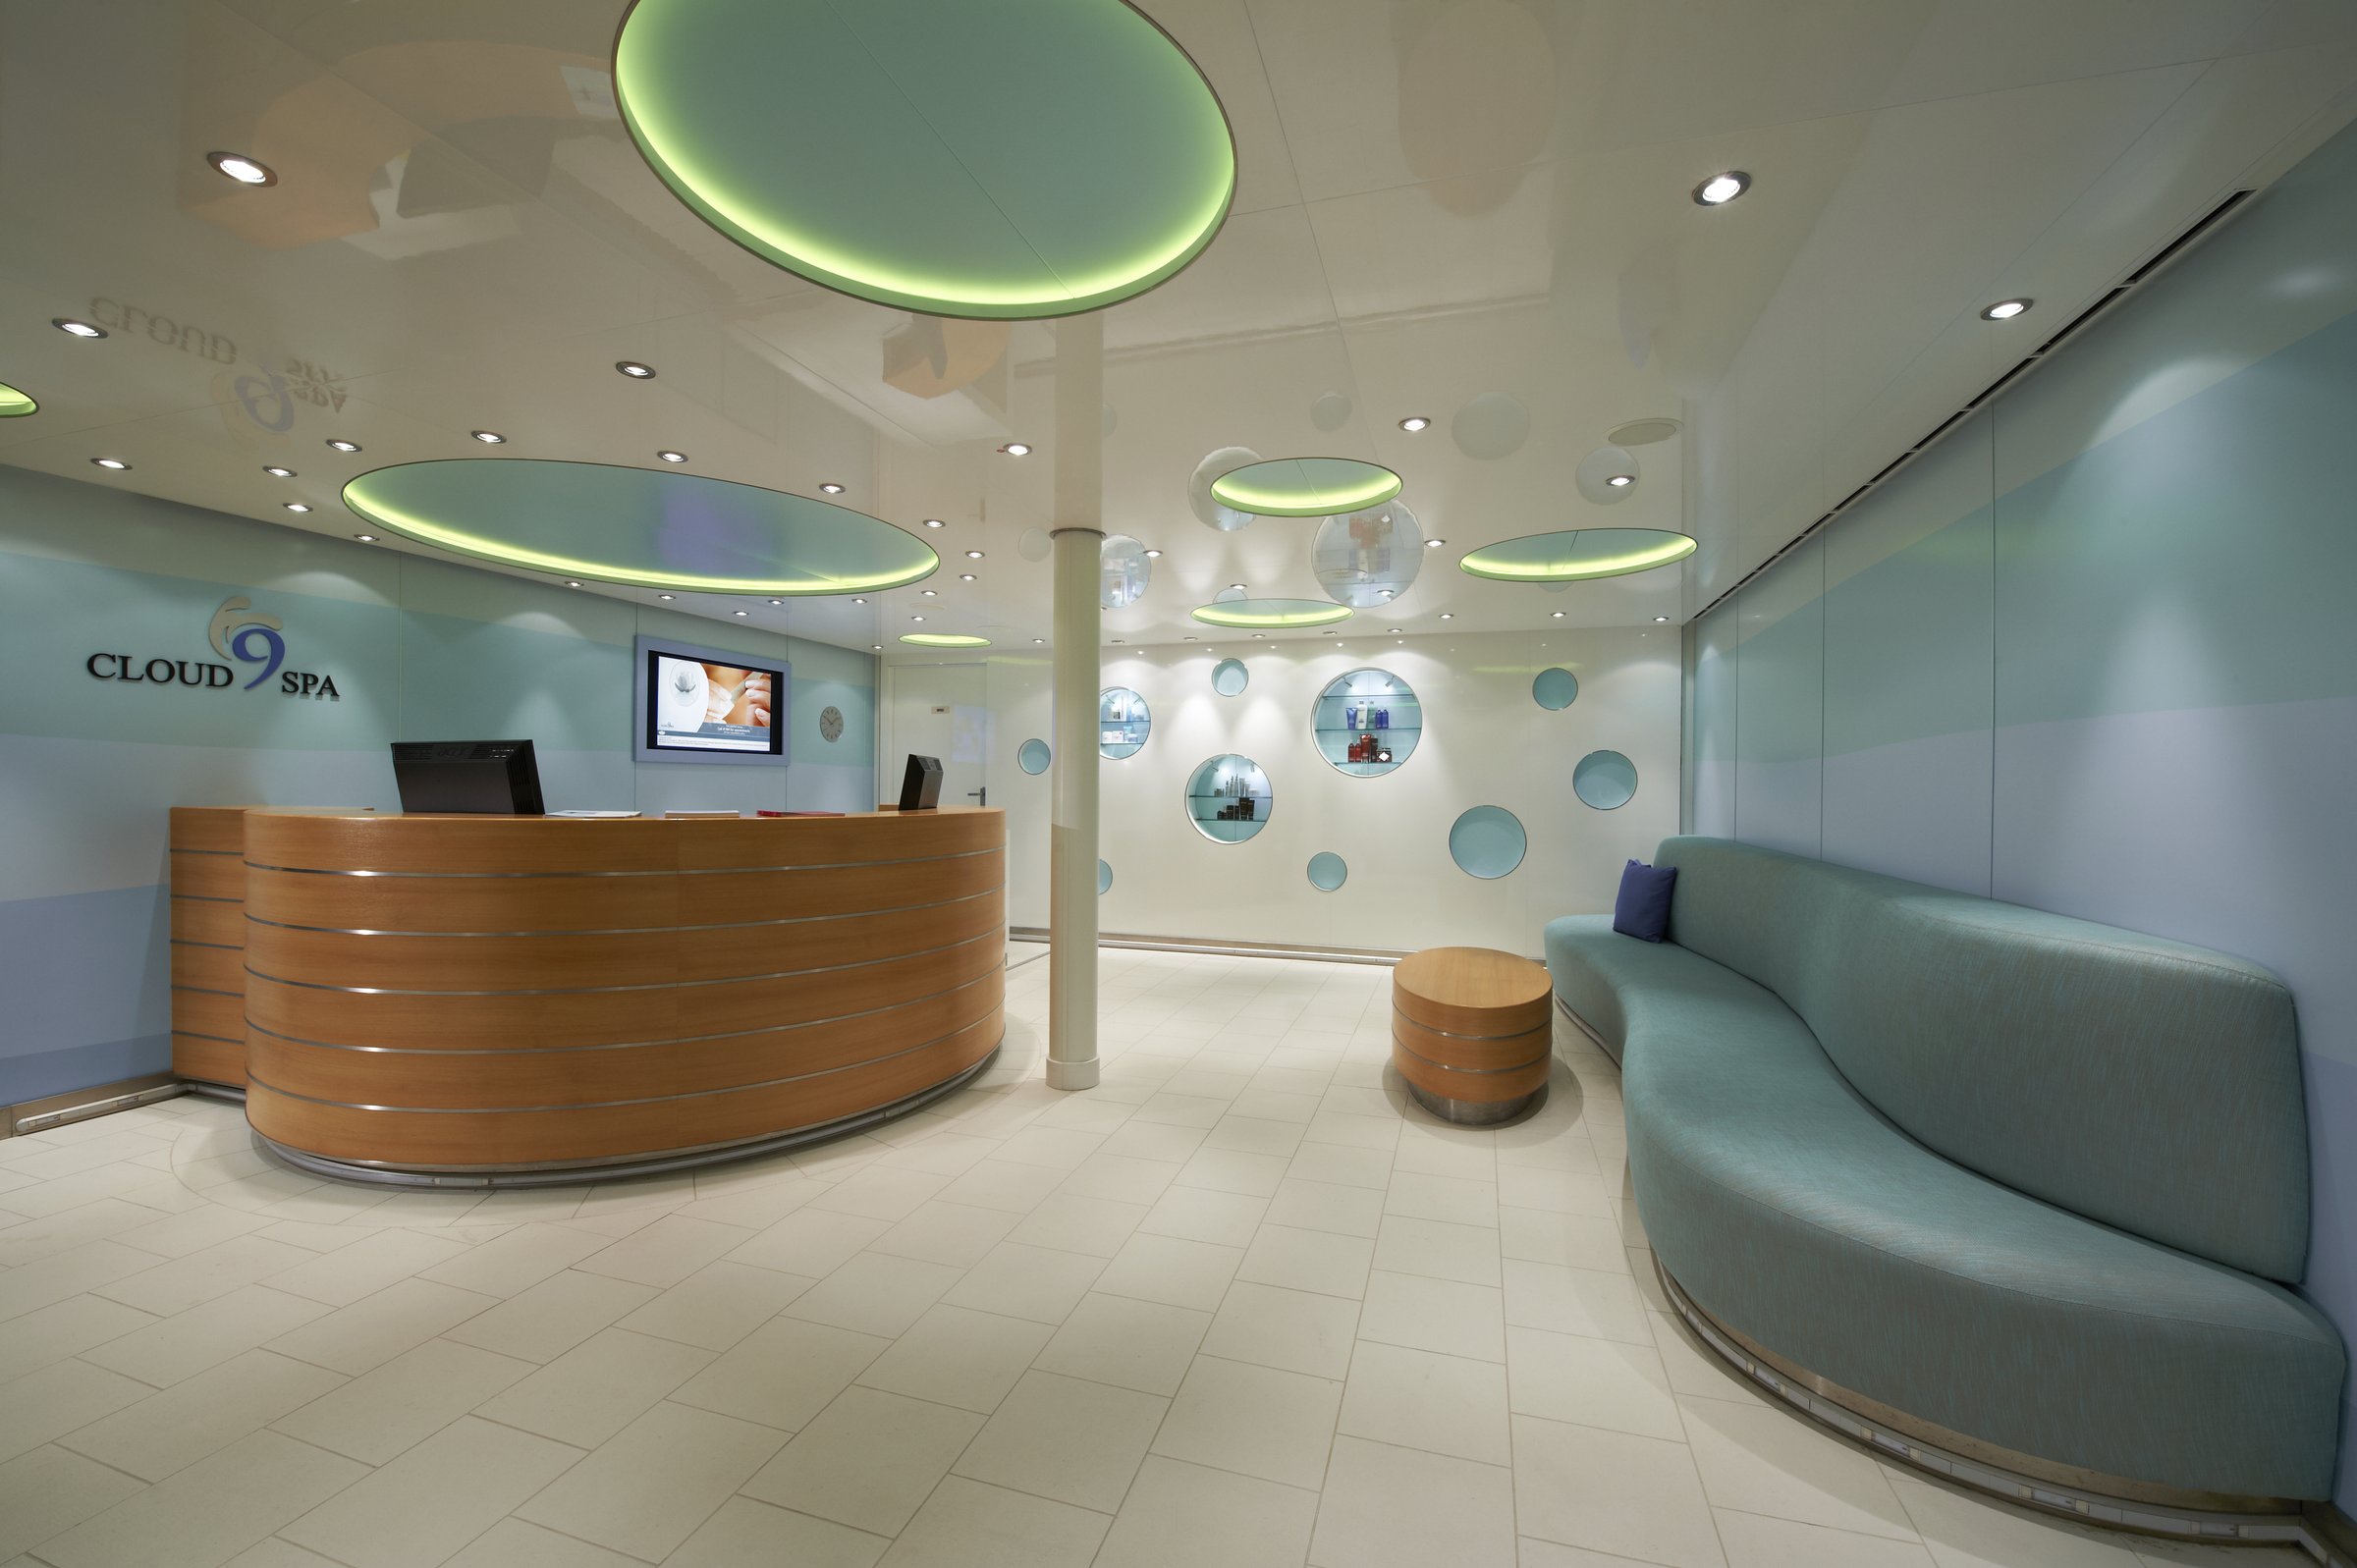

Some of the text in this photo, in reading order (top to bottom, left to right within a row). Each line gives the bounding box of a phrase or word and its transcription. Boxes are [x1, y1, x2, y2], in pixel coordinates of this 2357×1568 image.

[86, 627, 340, 698] CLOUD 9 SPA
